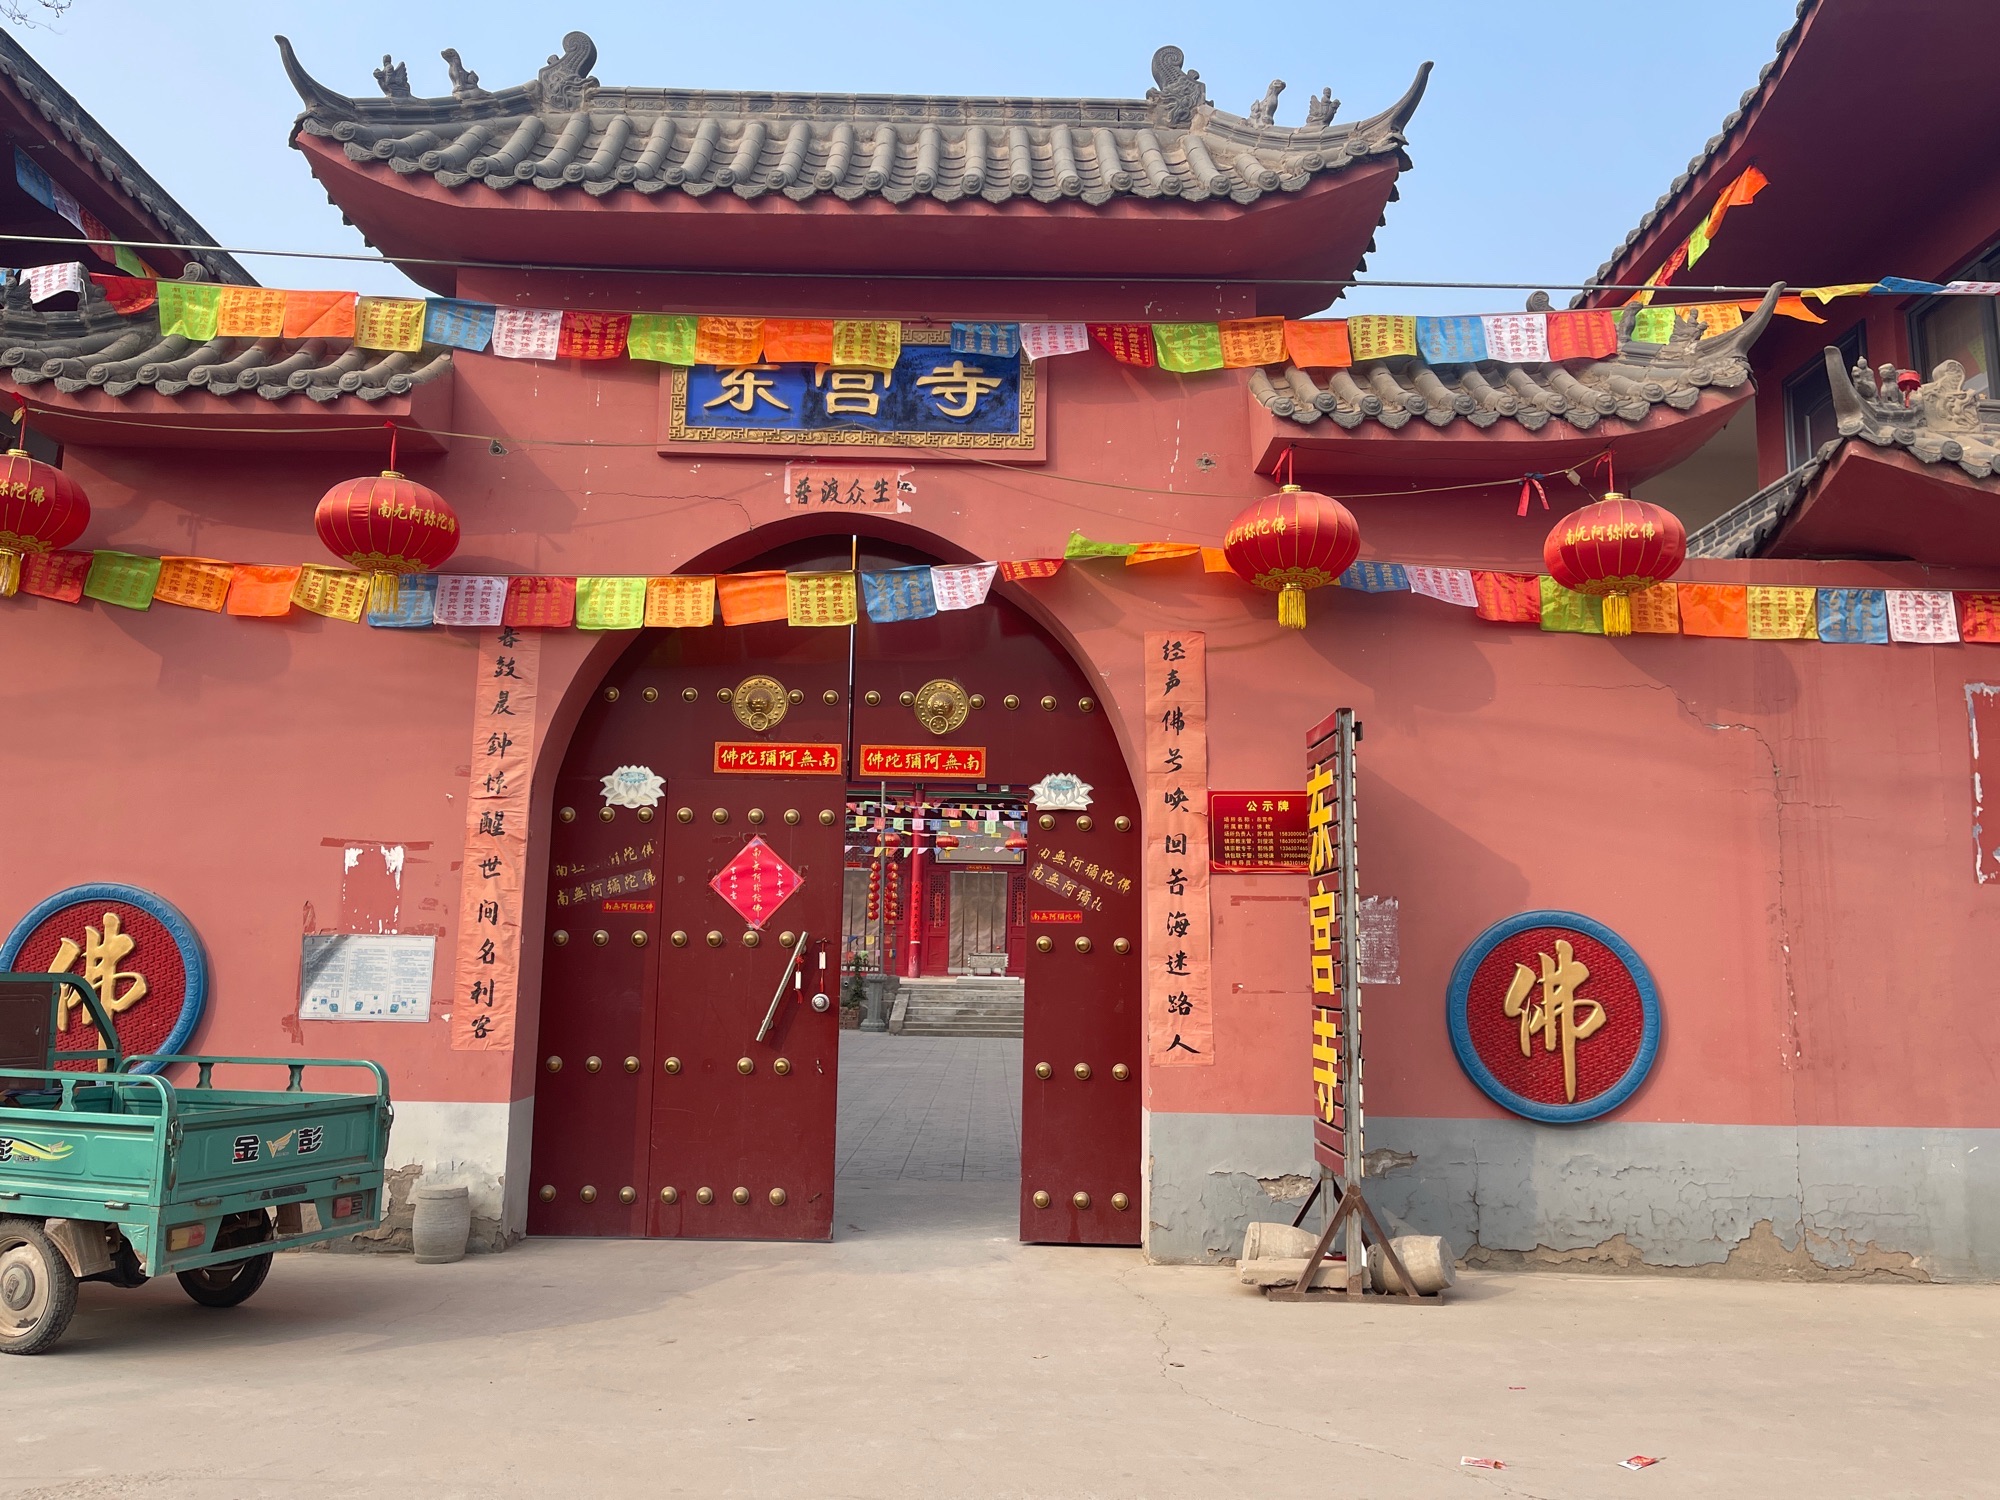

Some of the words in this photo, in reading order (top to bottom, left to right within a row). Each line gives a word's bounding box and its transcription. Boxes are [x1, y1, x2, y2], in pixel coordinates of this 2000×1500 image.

[795, 477, 890, 505] 普渡众生
[1246, 800, 1290, 812] 公示牌
[48, 912, 148, 1072] 佛
[1307, 763, 1338, 1123] 东宫寺
[1504, 939, 1607, 1102] 佛
[232, 1134, 260, 1164] 金
[297, 1126, 324, 1155] 彭
